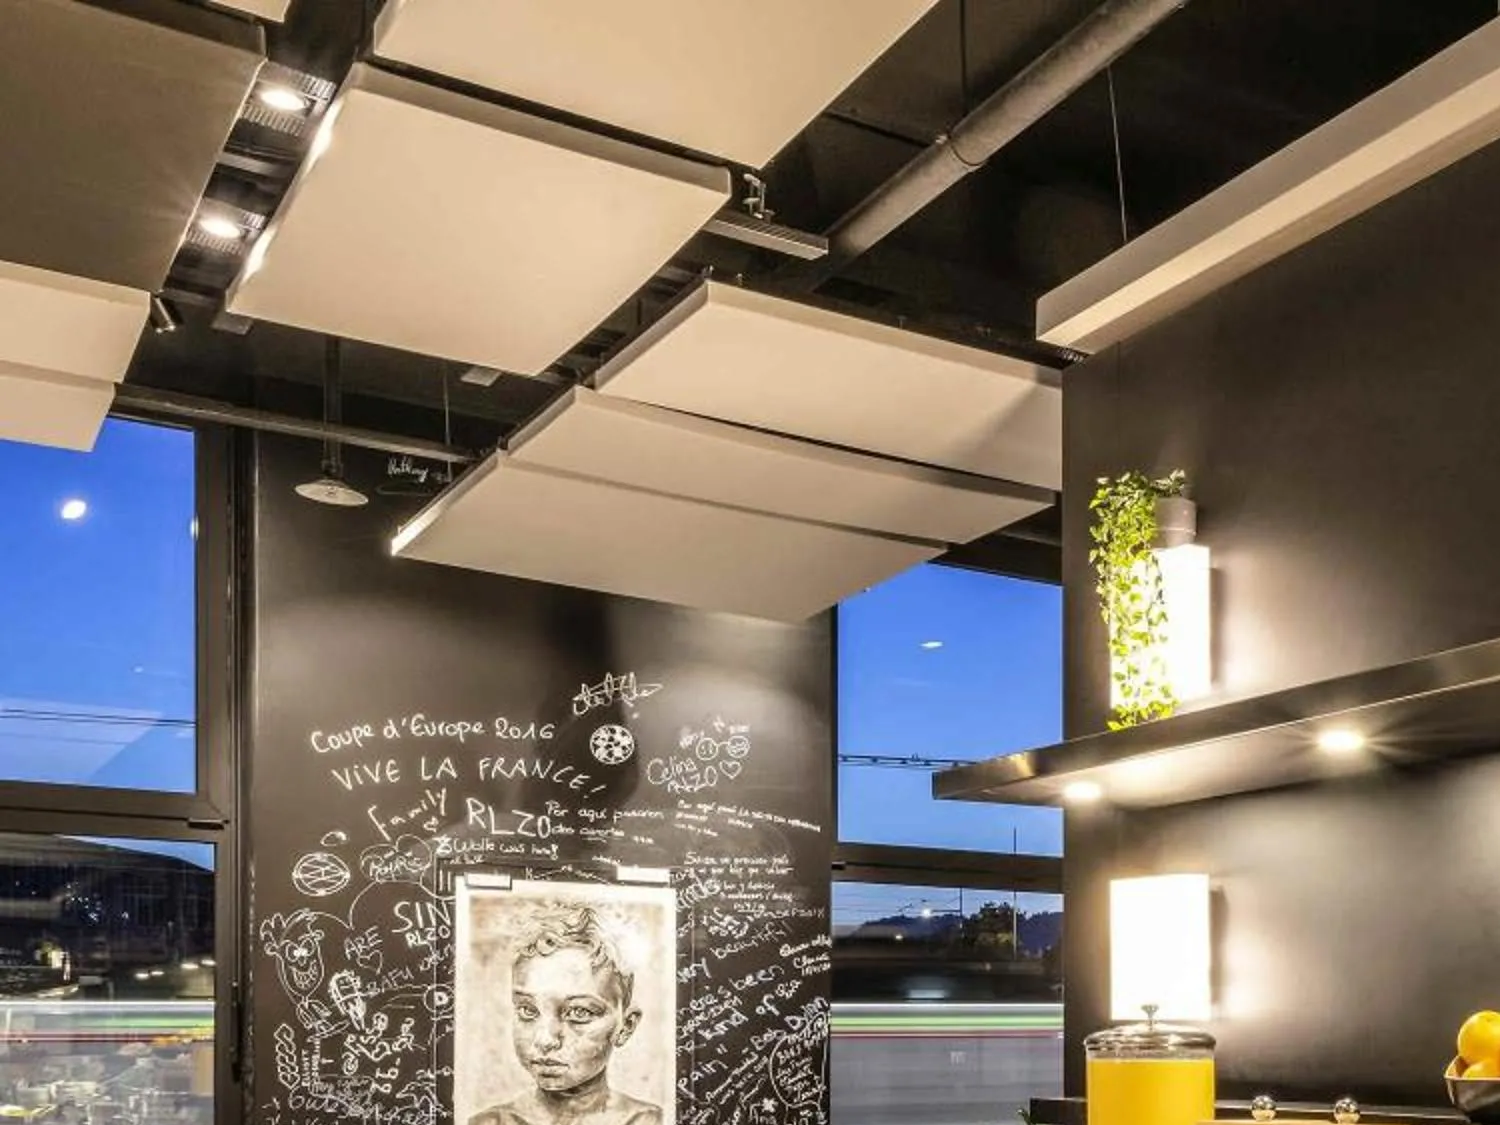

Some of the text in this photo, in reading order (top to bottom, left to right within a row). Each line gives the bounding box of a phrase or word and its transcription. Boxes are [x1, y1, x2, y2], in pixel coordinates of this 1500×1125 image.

[311, 713, 556, 753] Coupe d'Europe 2016
[420, 756, 458, 782] LA
